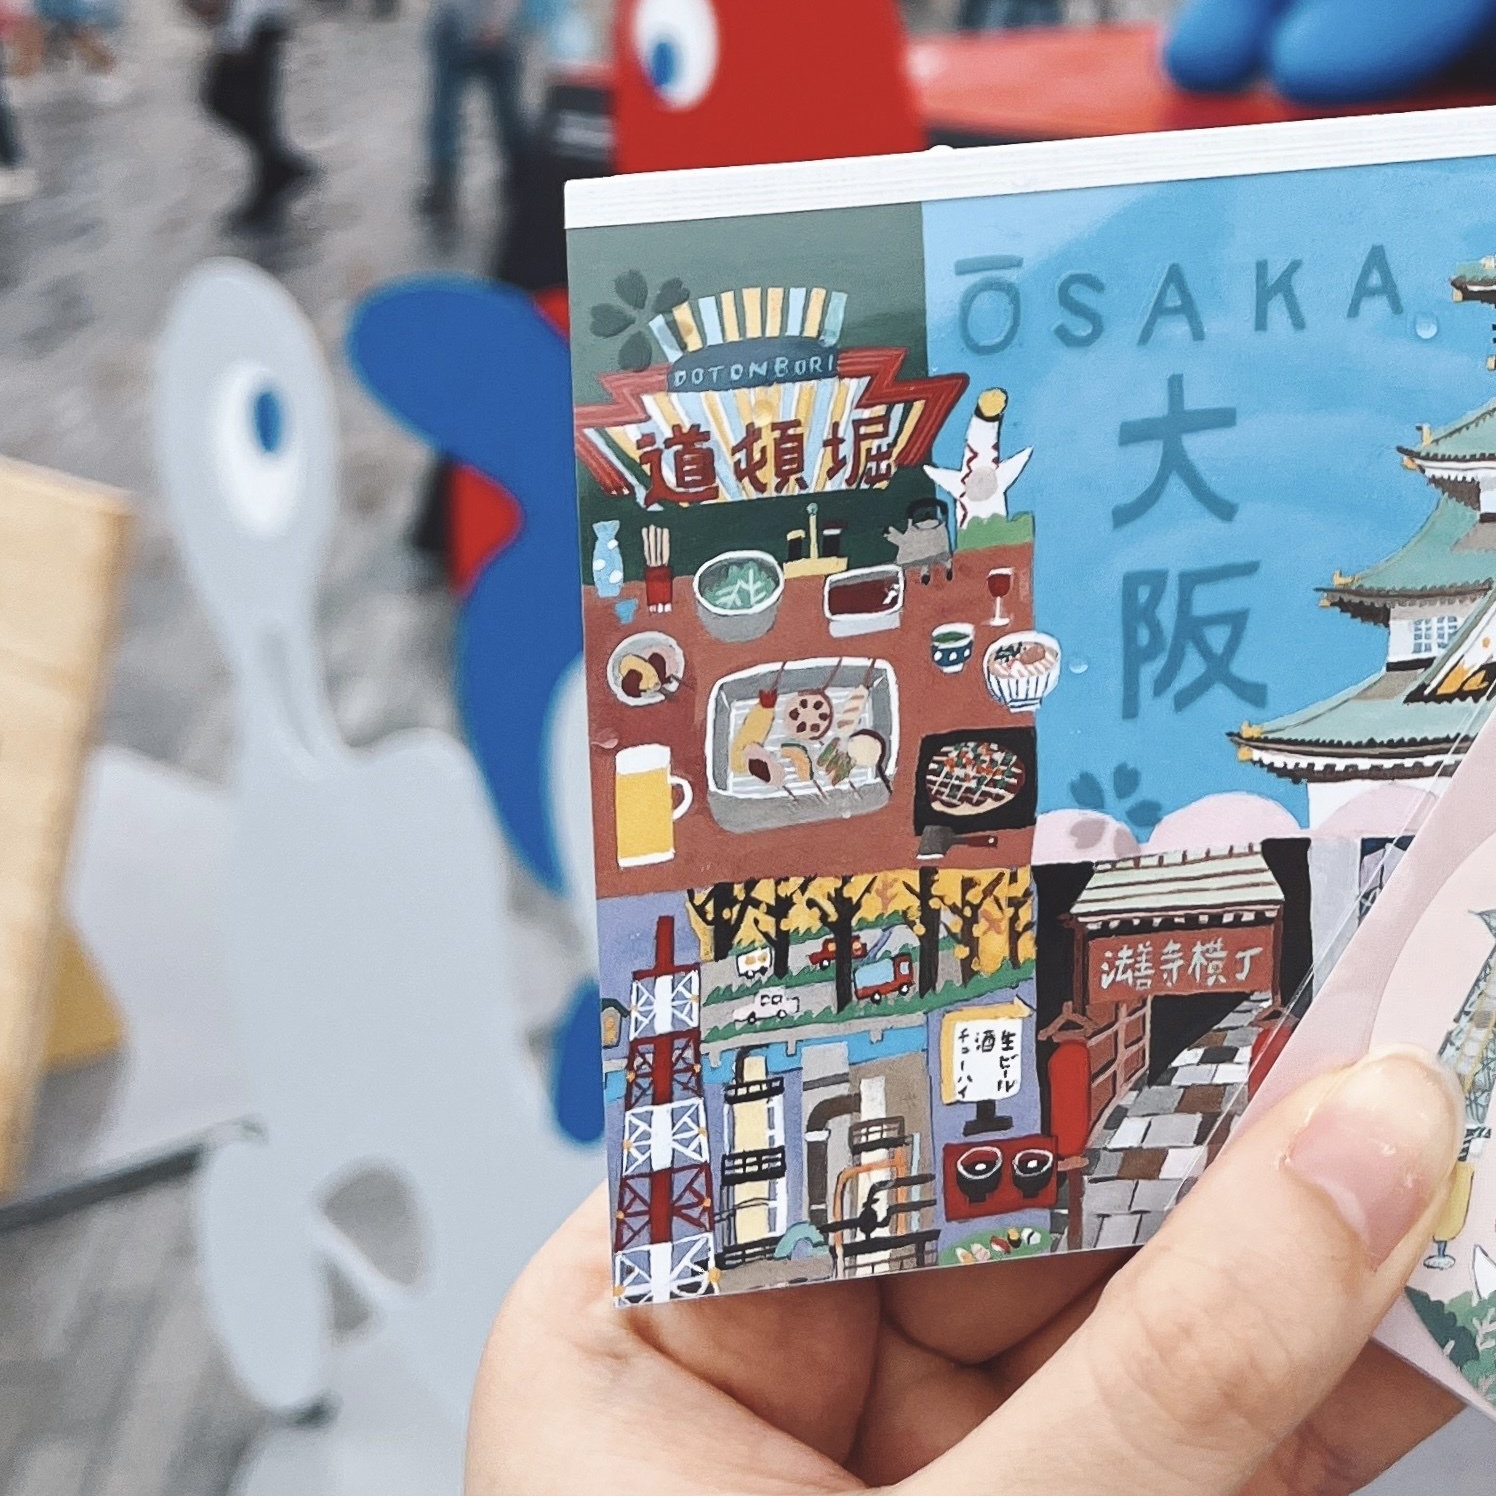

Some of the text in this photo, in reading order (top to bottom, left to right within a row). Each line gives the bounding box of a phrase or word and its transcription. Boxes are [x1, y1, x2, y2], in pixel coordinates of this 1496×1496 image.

[673, 353, 834, 388] DOTONBORI
[635, 413, 901, 507] 道頓堀
[1112, 372, 1268, 720] 大阪
[974, 1029, 997, 1053] 酒
[997, 1029, 1019, 1093] 生ビール
